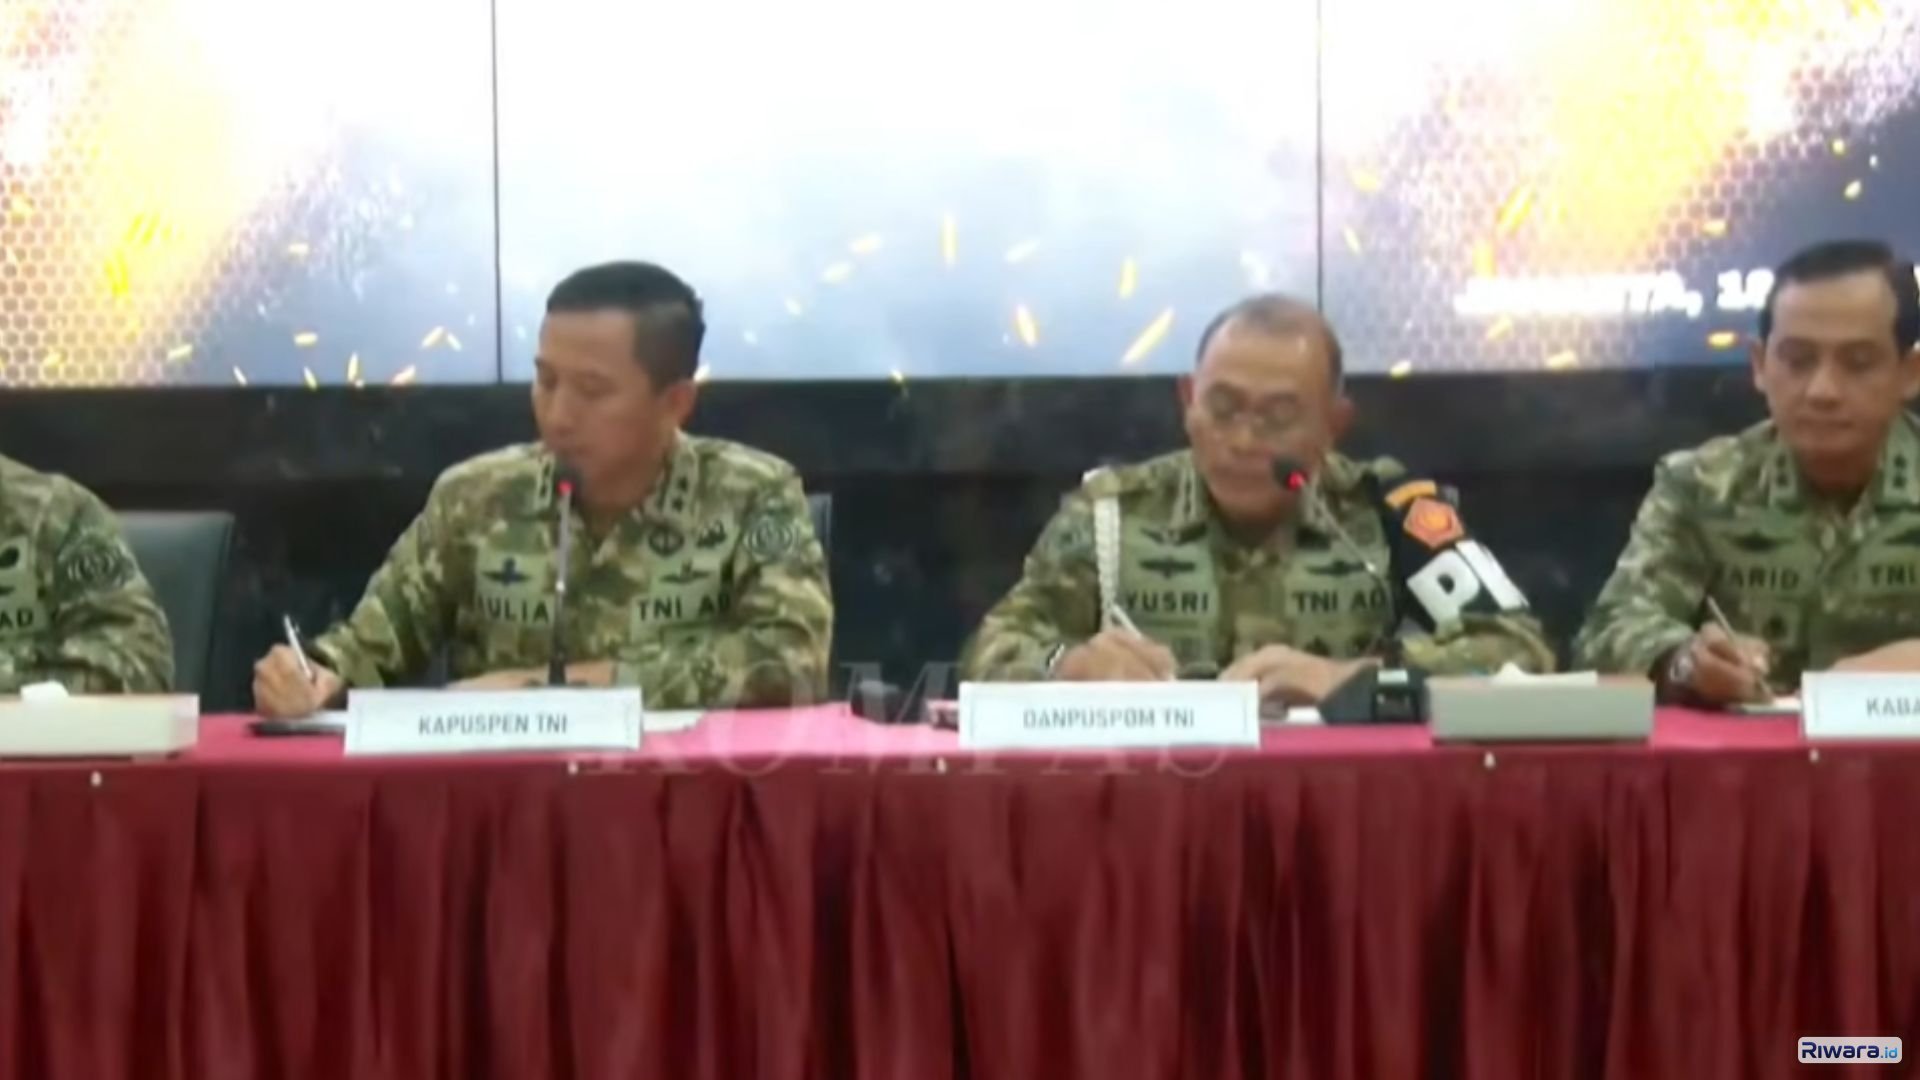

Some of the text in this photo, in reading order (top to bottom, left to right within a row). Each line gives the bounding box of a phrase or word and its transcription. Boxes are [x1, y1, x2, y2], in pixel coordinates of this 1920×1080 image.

[637, 595, 683, 621] TNI
[1126, 589, 1209, 614] YUSRI
[1292, 589, 1338, 613] TNI
[419, 714, 568, 736] KAPUSPEN TNI
[1023, 707, 1195, 730] DANPUSPOM TNI
